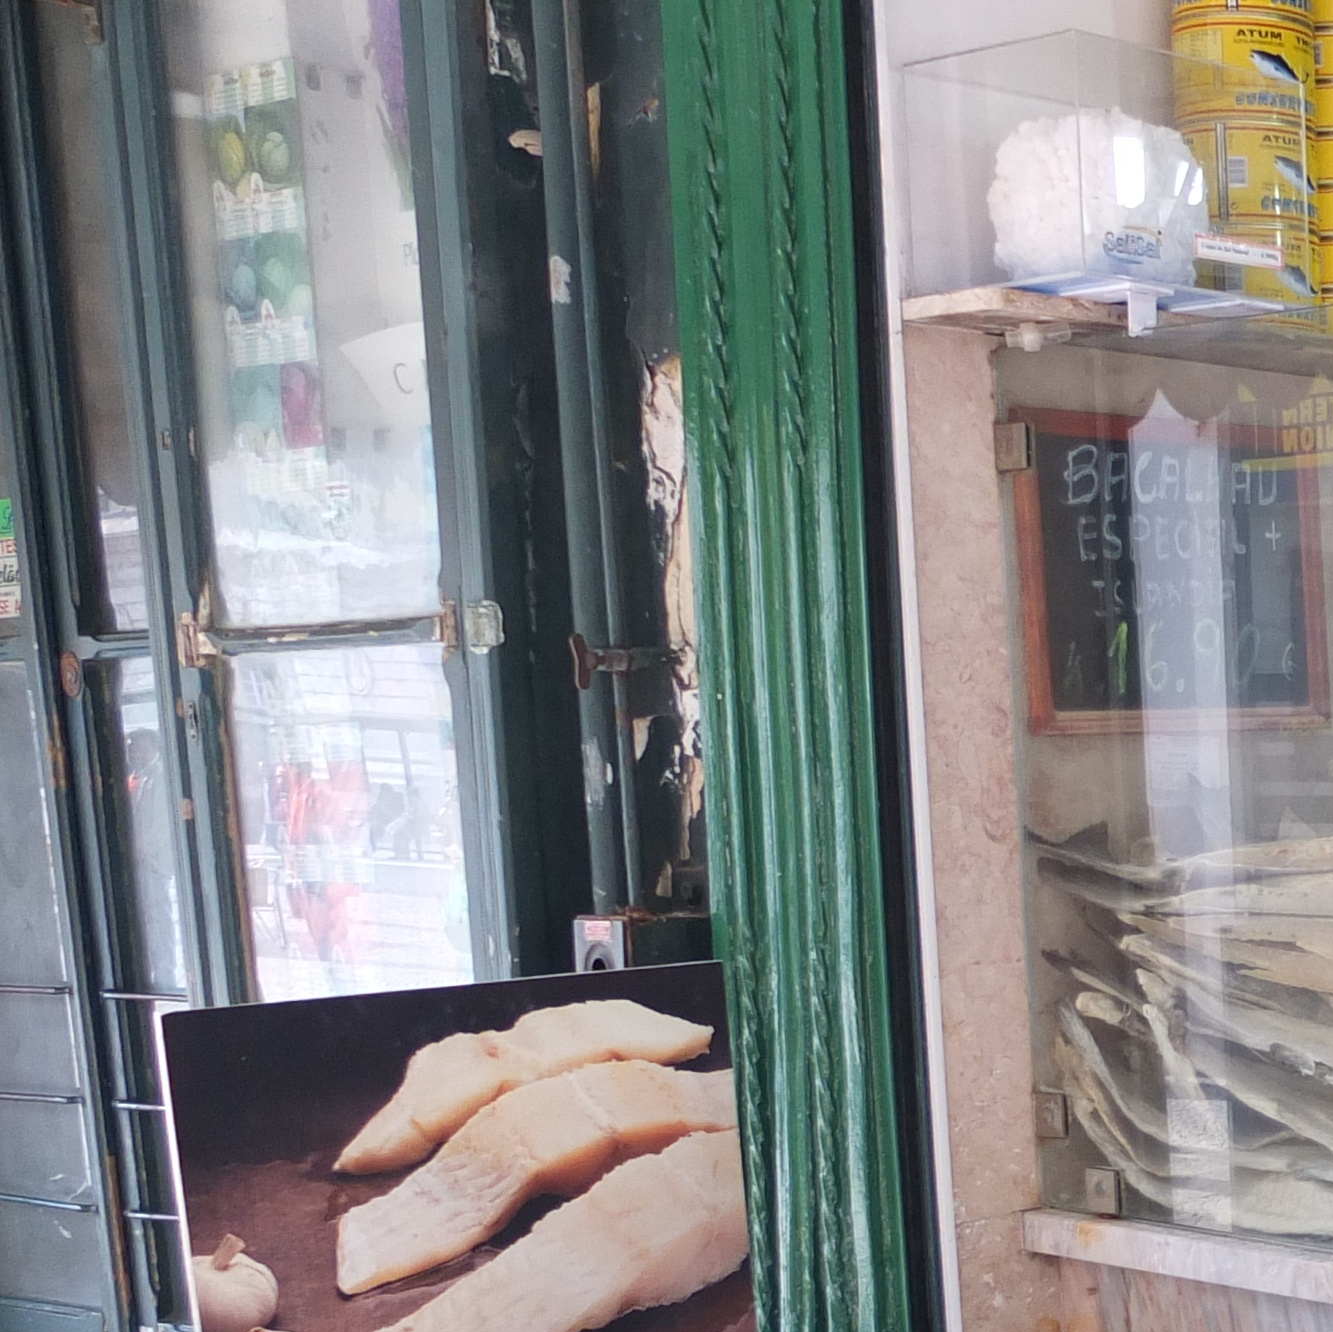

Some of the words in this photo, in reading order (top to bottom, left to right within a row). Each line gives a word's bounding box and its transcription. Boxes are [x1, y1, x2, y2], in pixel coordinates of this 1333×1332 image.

[1236, 28, 1283, 42] ATUM
[1063, 443, 1280, 506] BACALHAU
[1077, 510, 1247, 563] ESPECIAL
